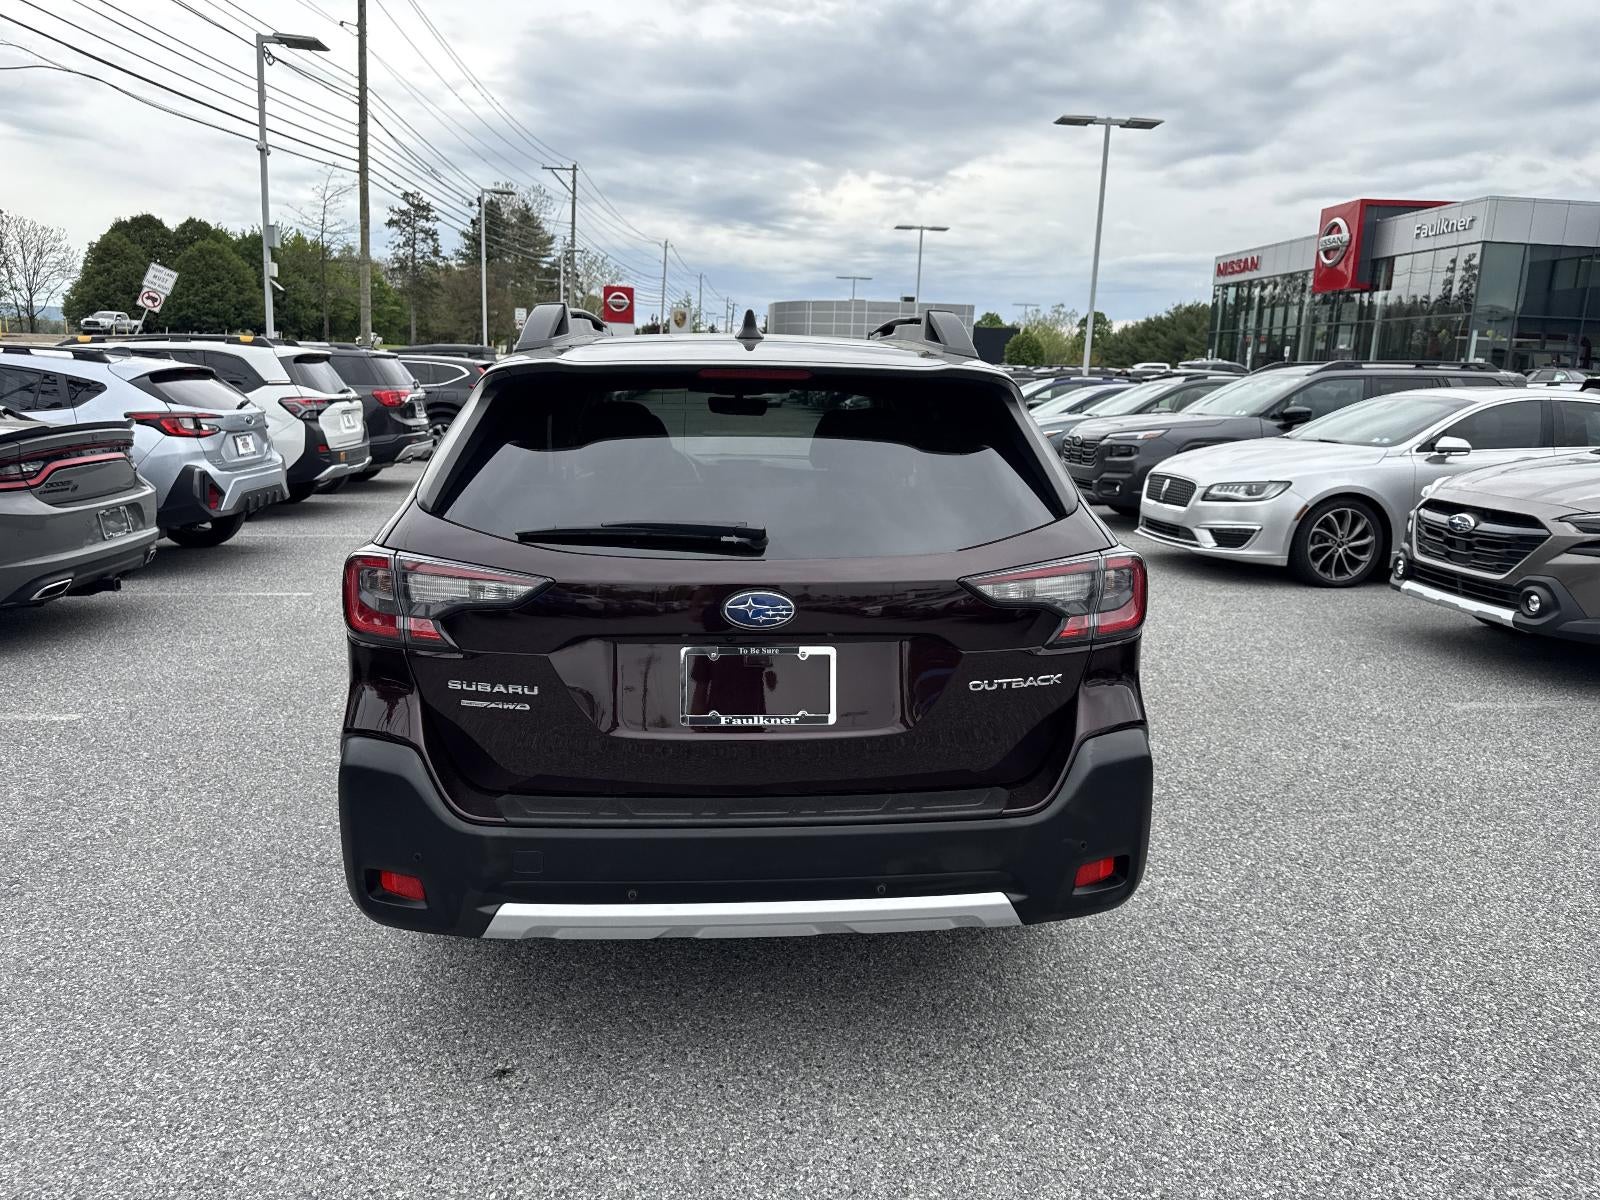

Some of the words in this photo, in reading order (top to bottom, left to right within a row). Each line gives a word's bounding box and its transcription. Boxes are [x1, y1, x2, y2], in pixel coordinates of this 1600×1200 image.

[1414, 217, 1474, 239] Faulkner
[1216, 255, 1261, 277] NISSAN
[738, 647, 748, 655] To
[447, 680, 539, 695] SUBARU
[968, 673, 1063, 691] OUTBACK
[720, 716, 800, 725] Faulkner
